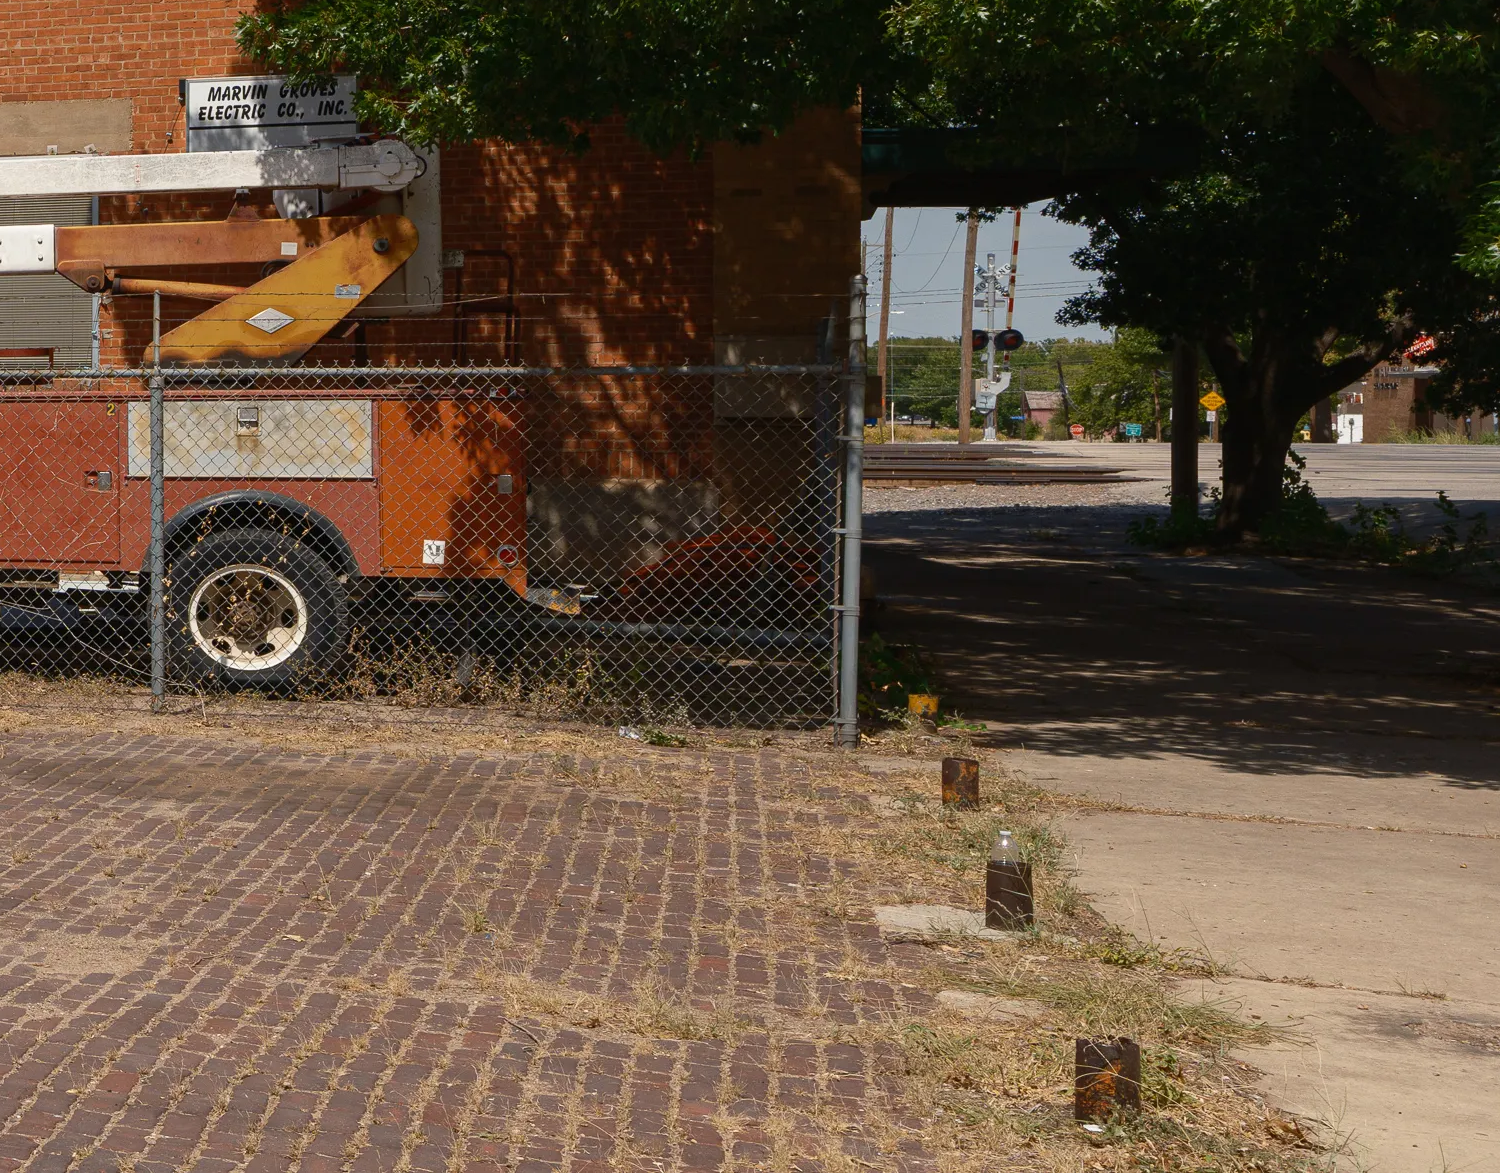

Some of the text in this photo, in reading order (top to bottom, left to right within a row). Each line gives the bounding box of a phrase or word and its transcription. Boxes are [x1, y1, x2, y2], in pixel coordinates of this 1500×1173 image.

[207, 82, 336, 102] MARVIN GROVES
[198, 99, 348, 121] ELECTRIC CO., INC.
[106, 403, 116, 416] 2
